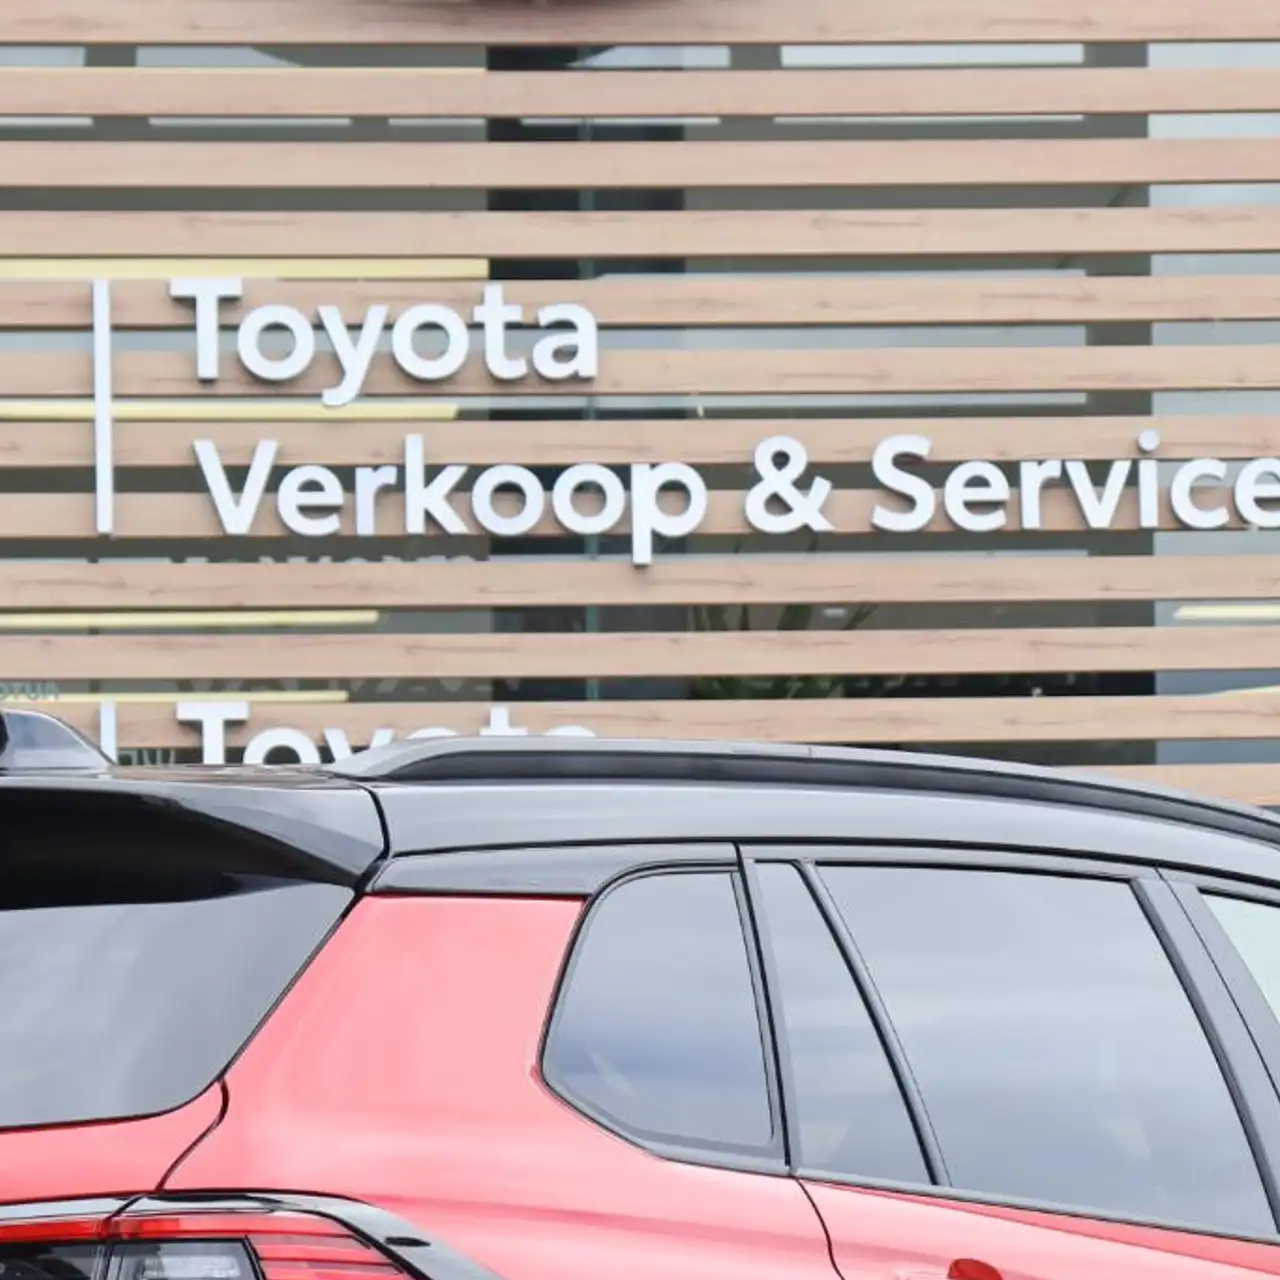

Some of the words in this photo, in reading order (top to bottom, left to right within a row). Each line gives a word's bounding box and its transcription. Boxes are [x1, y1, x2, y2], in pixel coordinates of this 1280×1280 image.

[169, 277, 598, 406] Toyota
[193, 434, 708, 566] Verkoop
[744, 435, 834, 533] &
